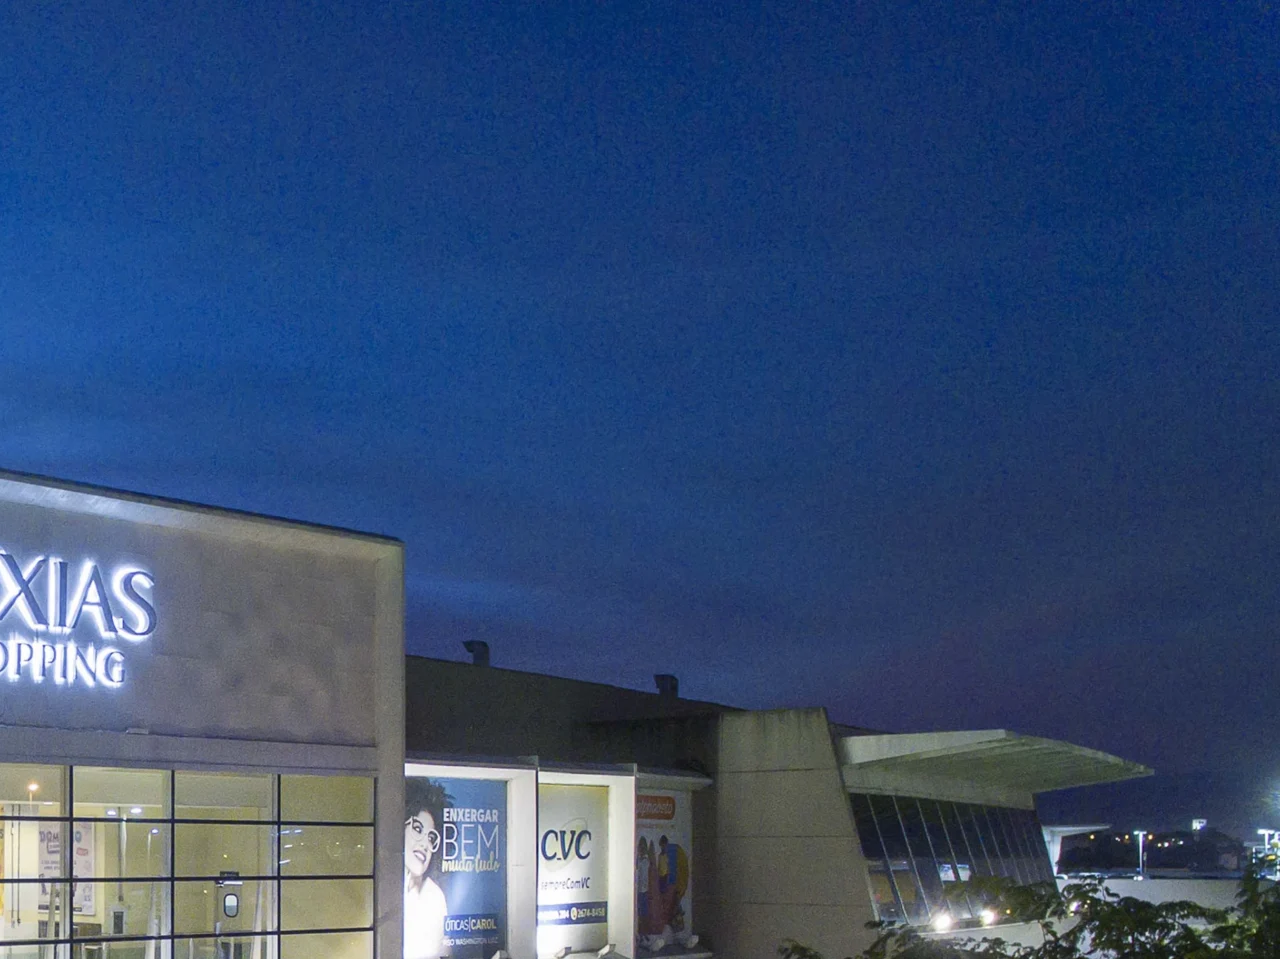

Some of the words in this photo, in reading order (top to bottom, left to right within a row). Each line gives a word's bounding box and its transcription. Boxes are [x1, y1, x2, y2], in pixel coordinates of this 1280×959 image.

[443, 808, 499, 822] ENXERGAR
[443, 823, 499, 860] BEM
[541, 829, 591, 860] CVC
[442, 851, 474, 873] muda
[471, 919, 496, 930] CAROL
